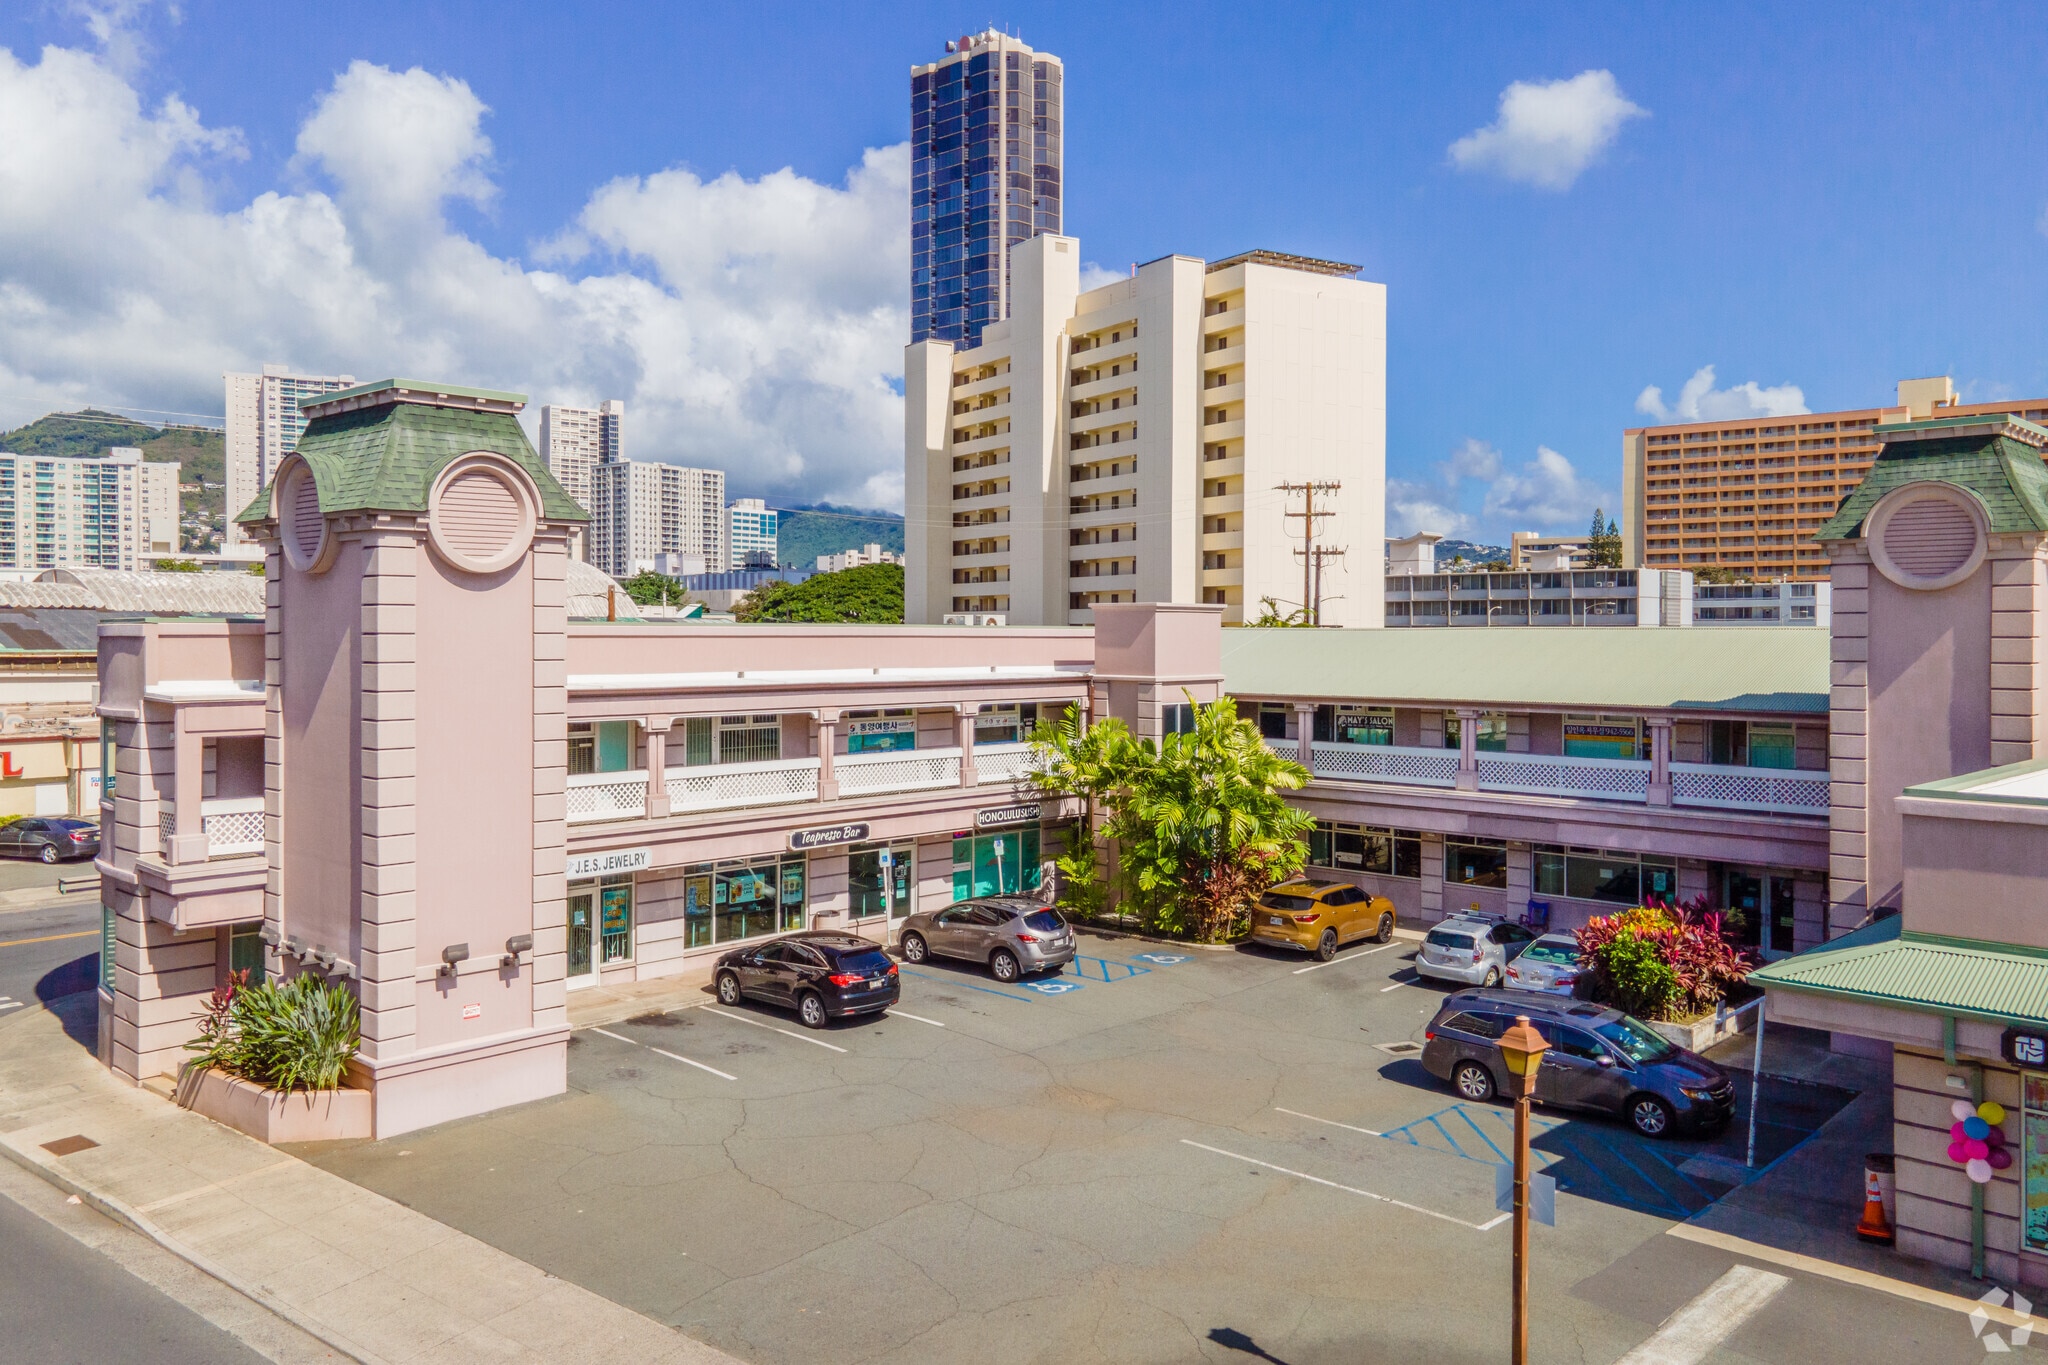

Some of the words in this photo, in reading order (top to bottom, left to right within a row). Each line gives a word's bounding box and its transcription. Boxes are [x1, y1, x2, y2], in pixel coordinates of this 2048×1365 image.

[1347, 716, 1368, 724] MAY'S
[1369, 717, 1393, 725] SALON
[802, 830, 841, 846] Teapresso
[843, 826, 860, 839] Bar
[575, 858, 601, 874] J.E.S.
[603, 852, 646, 870] JEWELRY
